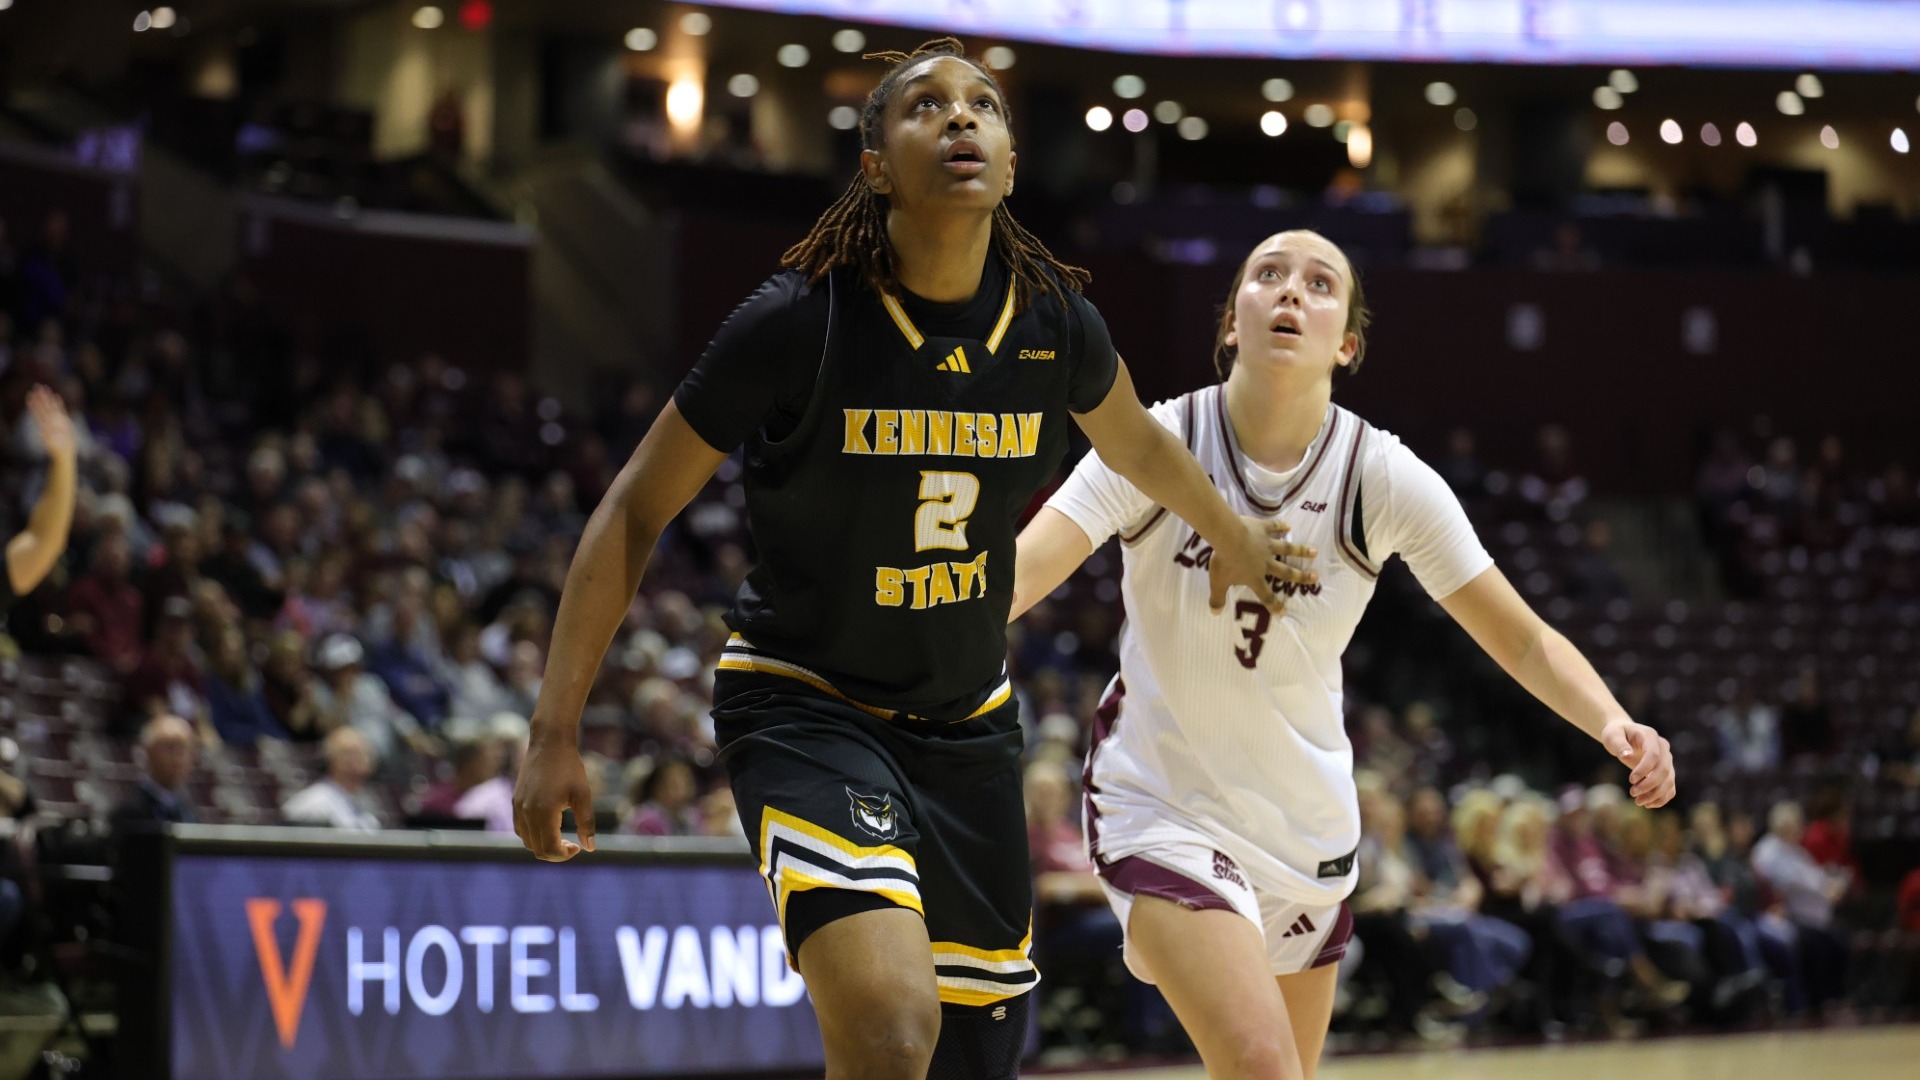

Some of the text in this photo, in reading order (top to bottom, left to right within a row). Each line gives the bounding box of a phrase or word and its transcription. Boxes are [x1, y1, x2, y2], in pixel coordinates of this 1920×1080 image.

[842, 408, 1043, 458] KENNESAW
[914, 470, 980, 552] 2
[1235, 600, 1272, 670] 3
[245, 897, 812, 1051] V HOTEL VAND
